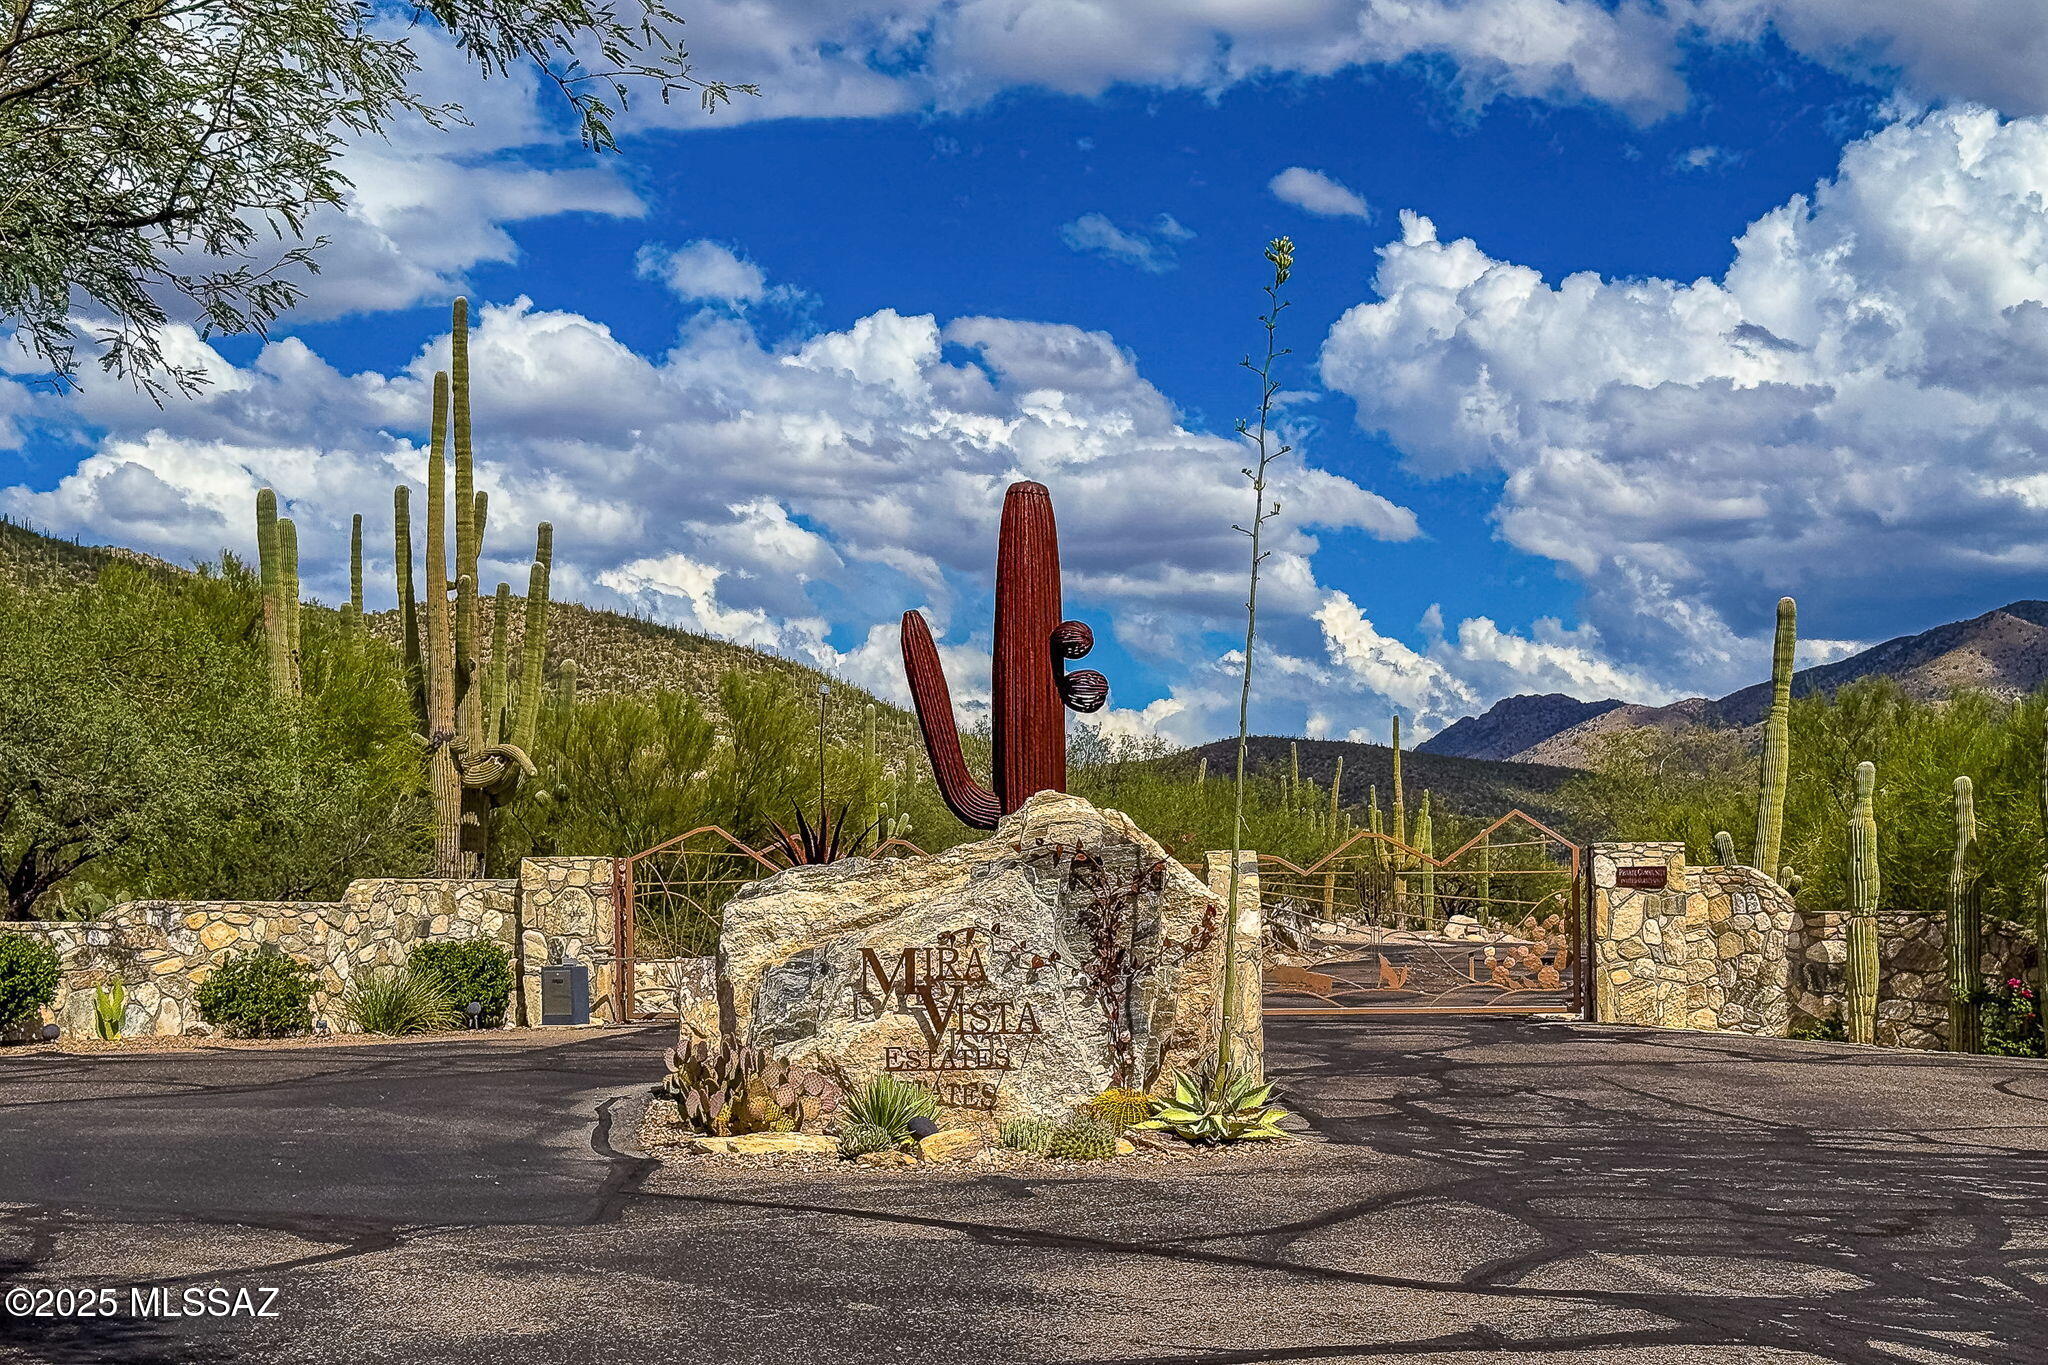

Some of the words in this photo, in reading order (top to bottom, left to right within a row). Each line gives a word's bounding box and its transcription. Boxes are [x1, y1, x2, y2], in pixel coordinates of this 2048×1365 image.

[856, 947, 988, 995] MIRA
[917, 983, 1041, 1034] VISTA
[883, 1046, 1015, 1071] ESTATES
